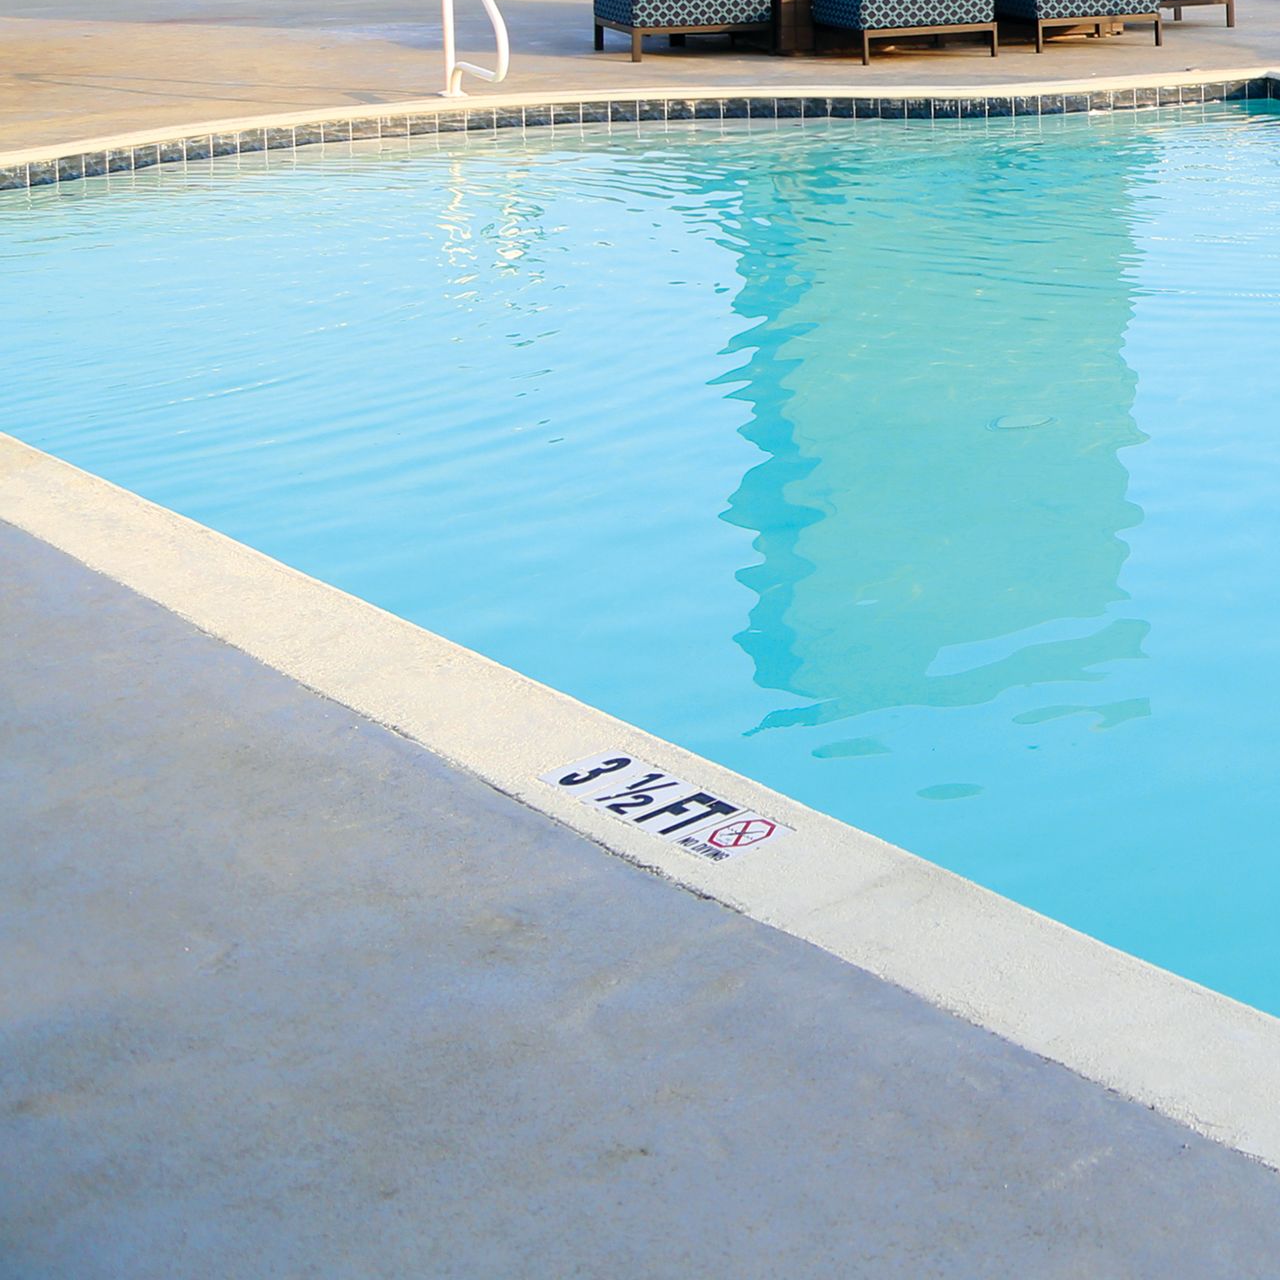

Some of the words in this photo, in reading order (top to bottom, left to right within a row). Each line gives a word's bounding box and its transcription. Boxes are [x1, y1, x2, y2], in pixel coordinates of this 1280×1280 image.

[559, 757, 631, 786] 3
[633, 792, 739, 835] FT
[677, 836, 699, 847] NO
[691, 843, 730, 861] DIVING
